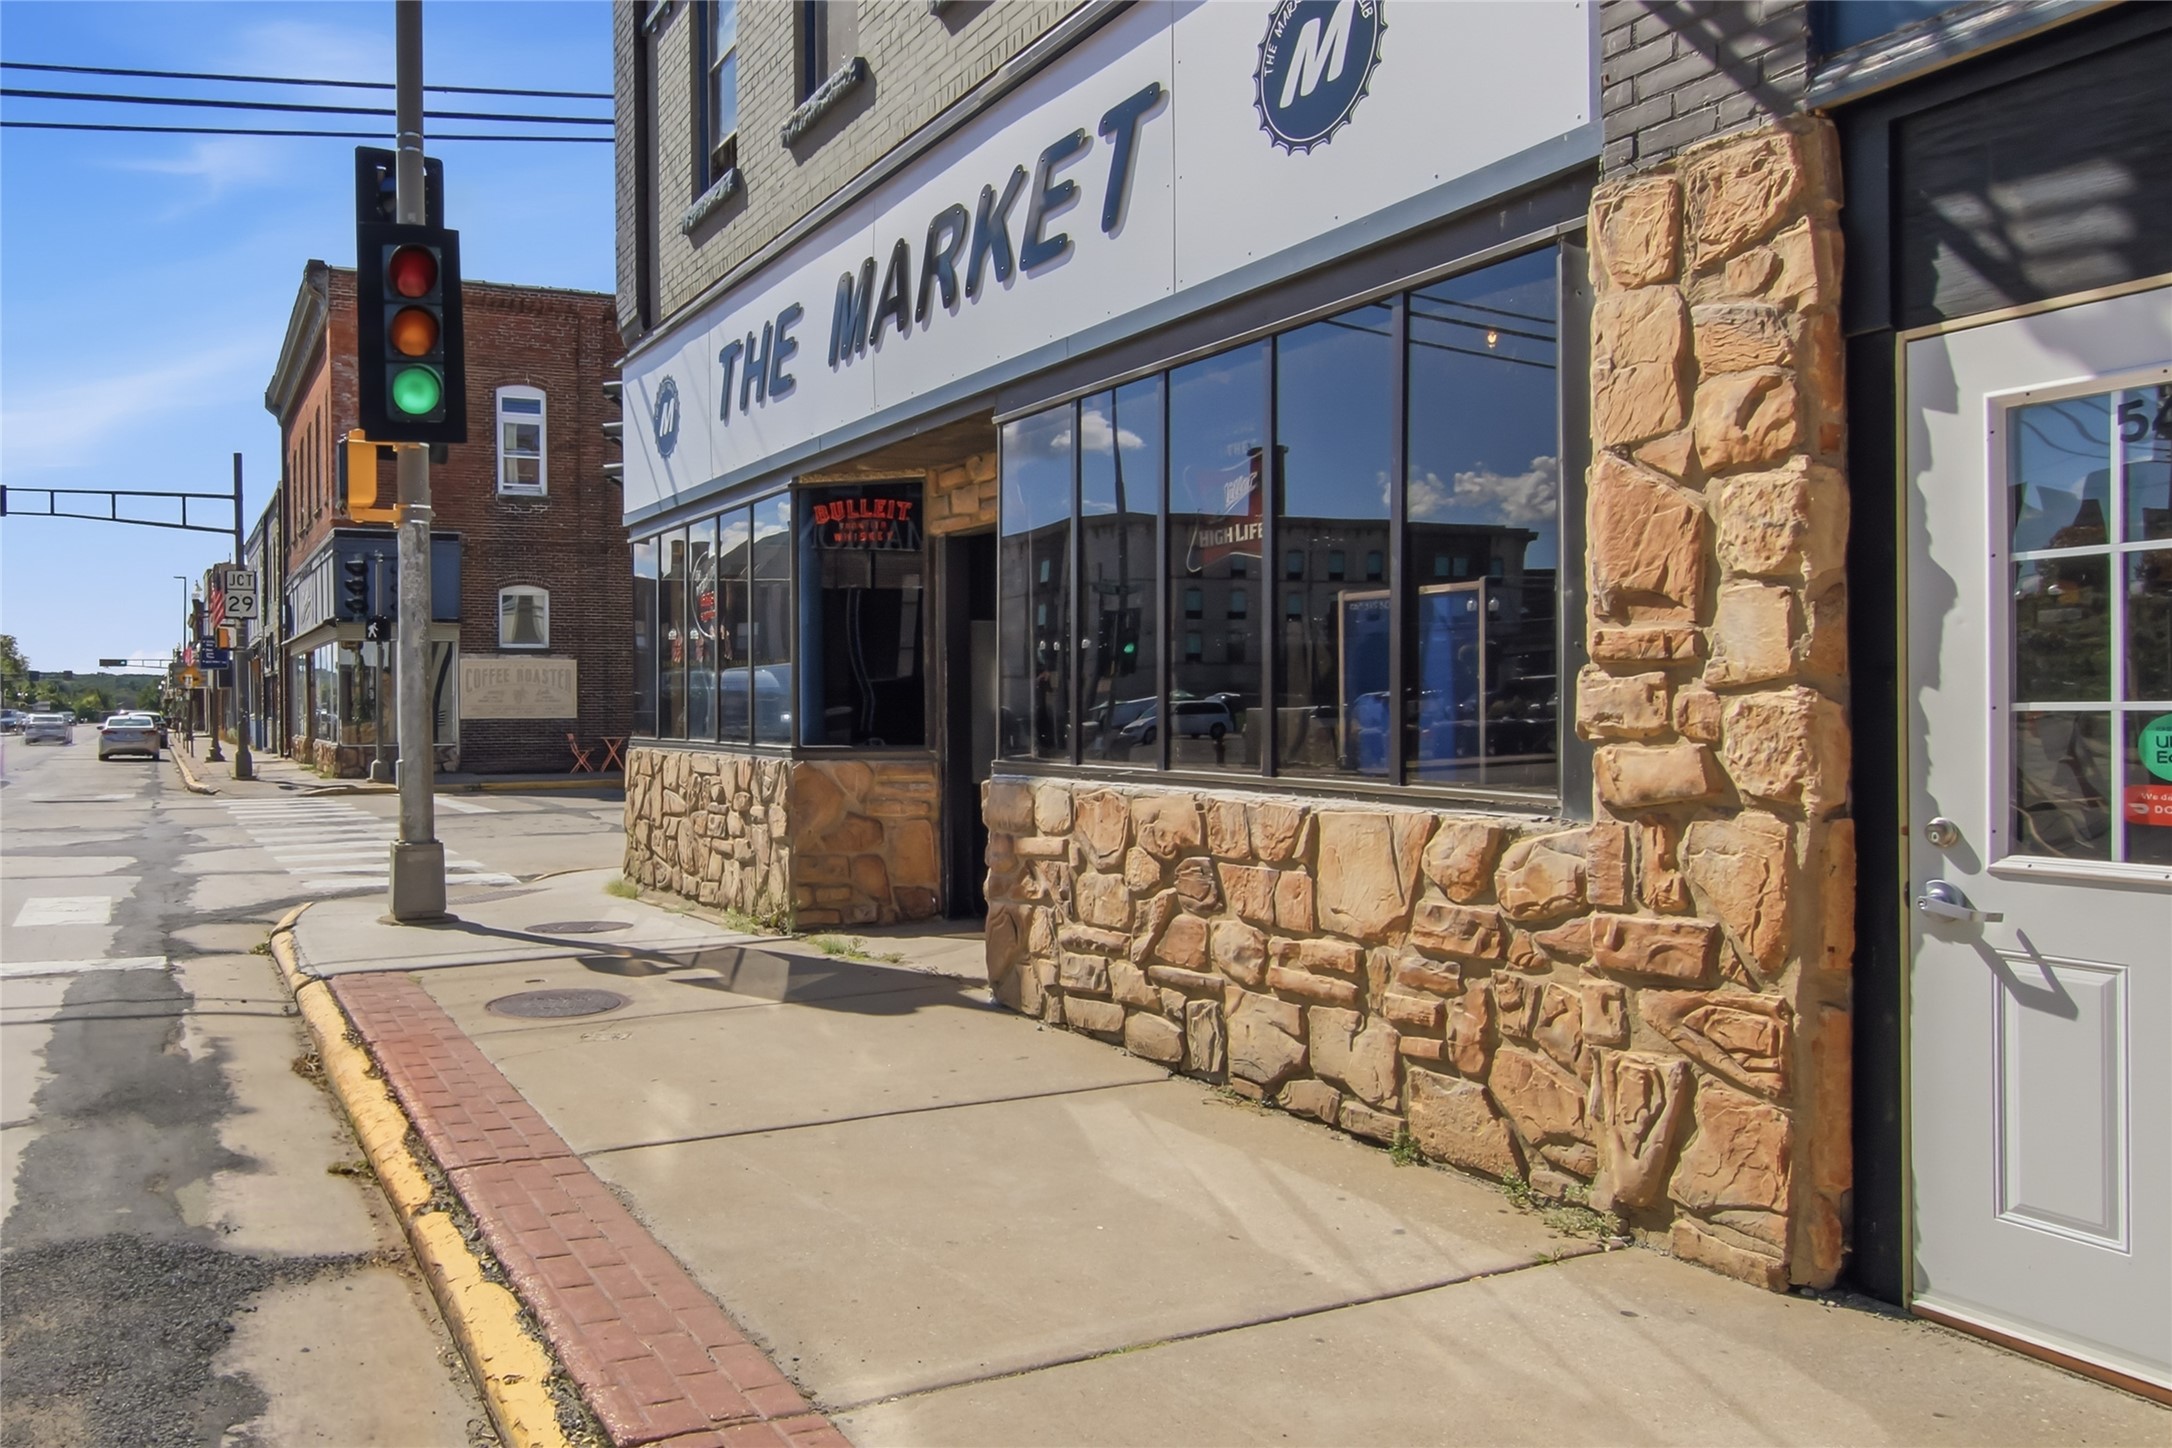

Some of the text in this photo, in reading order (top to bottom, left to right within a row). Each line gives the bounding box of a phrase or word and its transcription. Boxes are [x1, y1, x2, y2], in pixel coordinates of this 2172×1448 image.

[1264, 43, 1278, 77] THE
[1274, 0, 1303, 38] MAR
[1279, 0, 1356, 109] M
[719, 81, 1162, 421] THE MARKET
[659, 397, 675, 437] M
[813, 498, 913, 525] BULLEIT
[1200, 522, 1263, 548] HIGH LIFE
[229, 574, 253, 586] JCT
[228, 596, 254, 612] 29
[465, 667, 572, 694] COFFEE ROASTER
